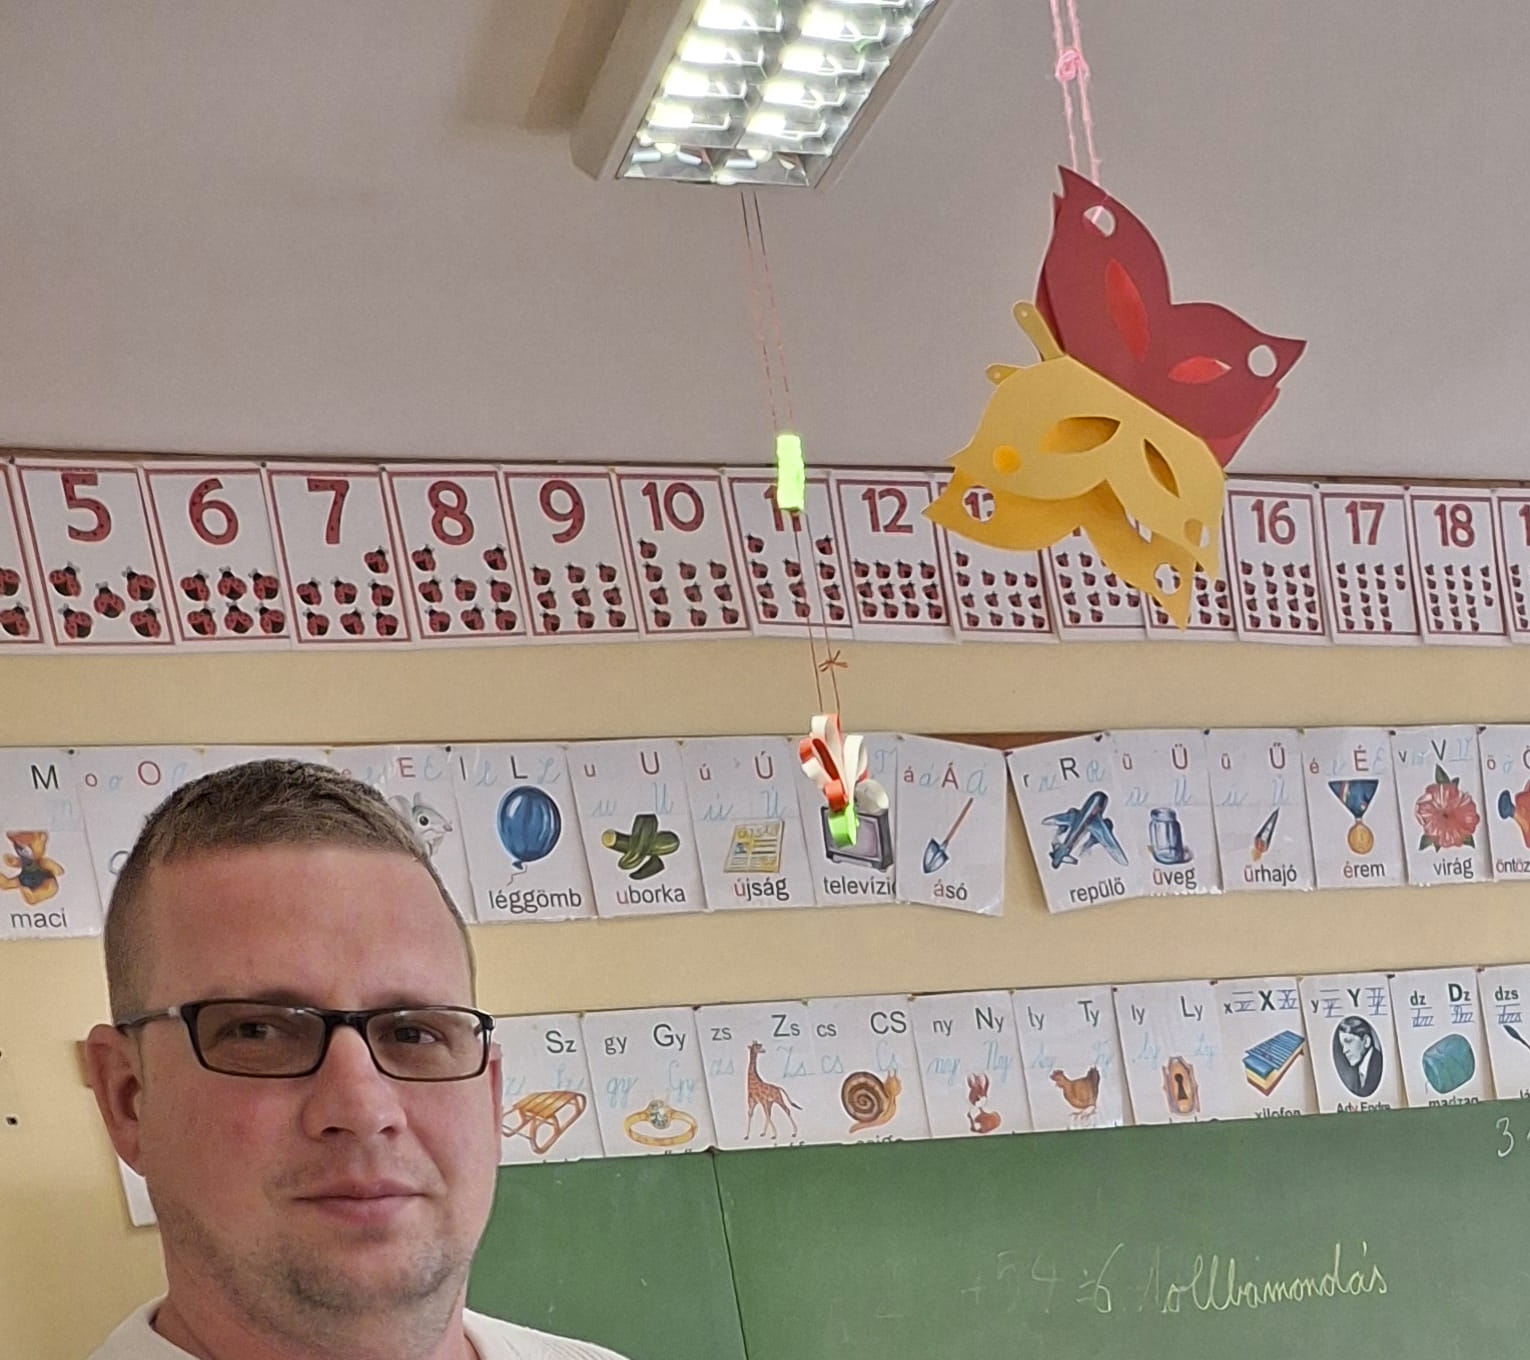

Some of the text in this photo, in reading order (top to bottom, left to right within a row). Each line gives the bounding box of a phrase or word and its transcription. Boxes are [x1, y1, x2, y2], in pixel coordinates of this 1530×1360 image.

[61, 472, 113, 543] 5
[189, 478, 239, 545] 6
[307, 478, 350, 545] 7
[428, 480, 475, 546] 8
[539, 480, 586, 544] 9
[641, 481, 705, 533] 10
[861, 487, 914, 534] 12
[1251, 499, 1296, 545] 16
[1344, 500, 1385, 546] 17
[1433, 503, 1475, 549] 18
[1353, 743, 1369, 772] É
[1431, 739, 1447, 760] V
[138, 761, 161, 785] O
[400, 757, 416, 778] E
[511, 756, 528, 779] L
[640, 751, 659, 775] U
[754, 751, 774, 780] Ú
[941, 762, 959, 789] Á
[1059, 757, 1080, 780] R
[31, 765, 59, 789] M
[1343, 859, 1385, 879] érem
[1433, 856, 1473, 879] virág
[489, 888, 583, 914] léggömb
[616, 884, 687, 906] uborka
[734, 876, 790, 901] újság
[933, 879, 967, 900] ásó
[10, 908, 68, 928] maci
[1258, 990, 1275, 1011] X
[1347, 988, 1361, 1007] Y
[1410, 983, 1472, 1006] dz Dz
[1494, 985, 1519, 1001] dzs
[1078, 1000, 1100, 1027] Ty
[1180, 995, 1204, 1020] Ly
[711, 1014, 801, 1041] zs Zs
[816, 1022, 837, 1038] cs
[932, 1006, 1004, 1036] ny Ny
[604, 1023, 686, 1056] gy Gy
[1496, 1117, 1514, 1157] 3
